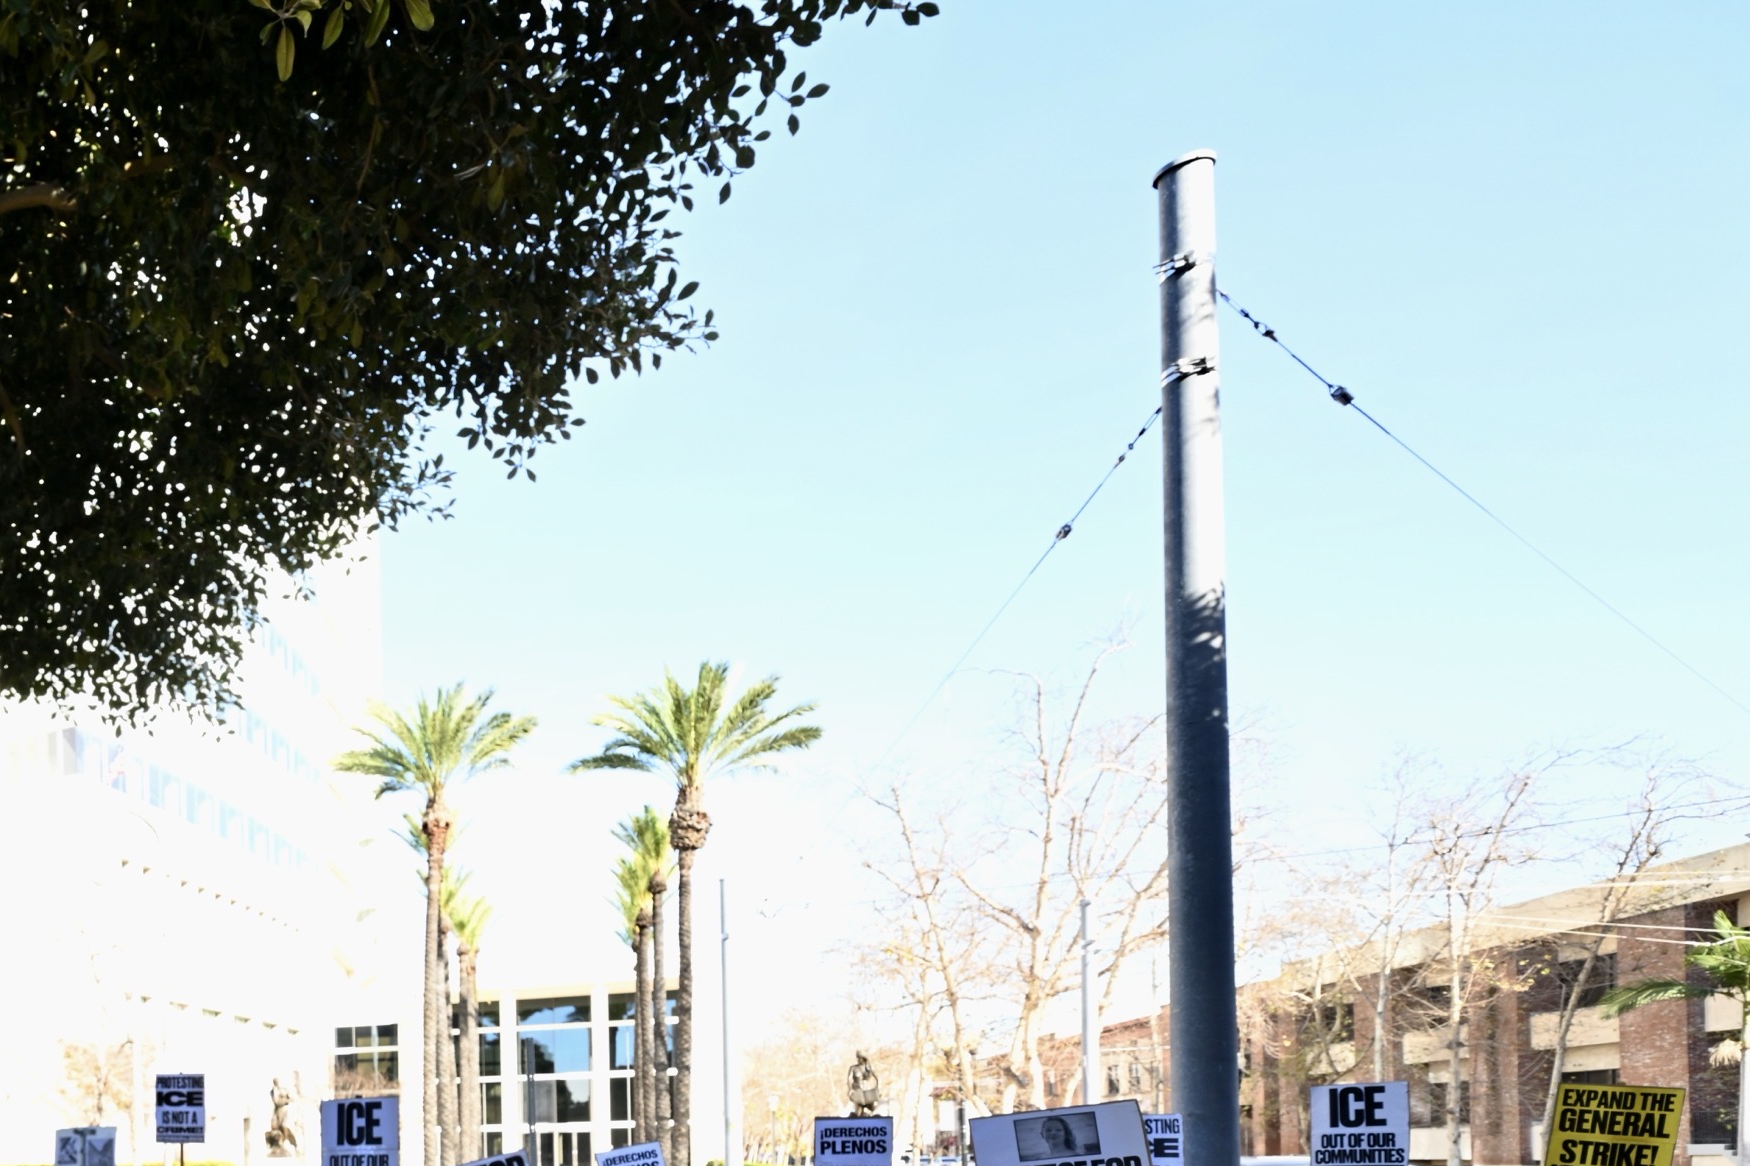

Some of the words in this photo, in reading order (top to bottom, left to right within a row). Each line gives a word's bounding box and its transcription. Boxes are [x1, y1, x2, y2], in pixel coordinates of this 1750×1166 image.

[156, 1076, 204, 1089] PROTESTING
[157, 1091, 203, 1107] ICE
[1329, 1086, 1387, 1128] ICE
[1562, 1089, 1636, 1110] EXPAND
[1640, 1093, 1677, 1112] THE
[162, 1111, 170, 1123] IS
[172, 1111, 188, 1123] NOT
[190, 1111, 198, 1123] A
[337, 1102, 382, 1145] ICE
[1559, 1108, 1670, 1138] GENERAL
[157, 1126, 203, 1134] CRIME!
[820, 1127, 887, 1139] ¡DERECHOS
[1145, 1118, 1180, 1134] STING
[820, 1139, 887, 1155] PLENOS
[1321, 1134, 1346, 1148] OUT
[1348, 1133, 1365, 1148] OF
[1367, 1133, 1396, 1148] OUR
[1315, 1148, 1405, 1164] COMMUNITIES
